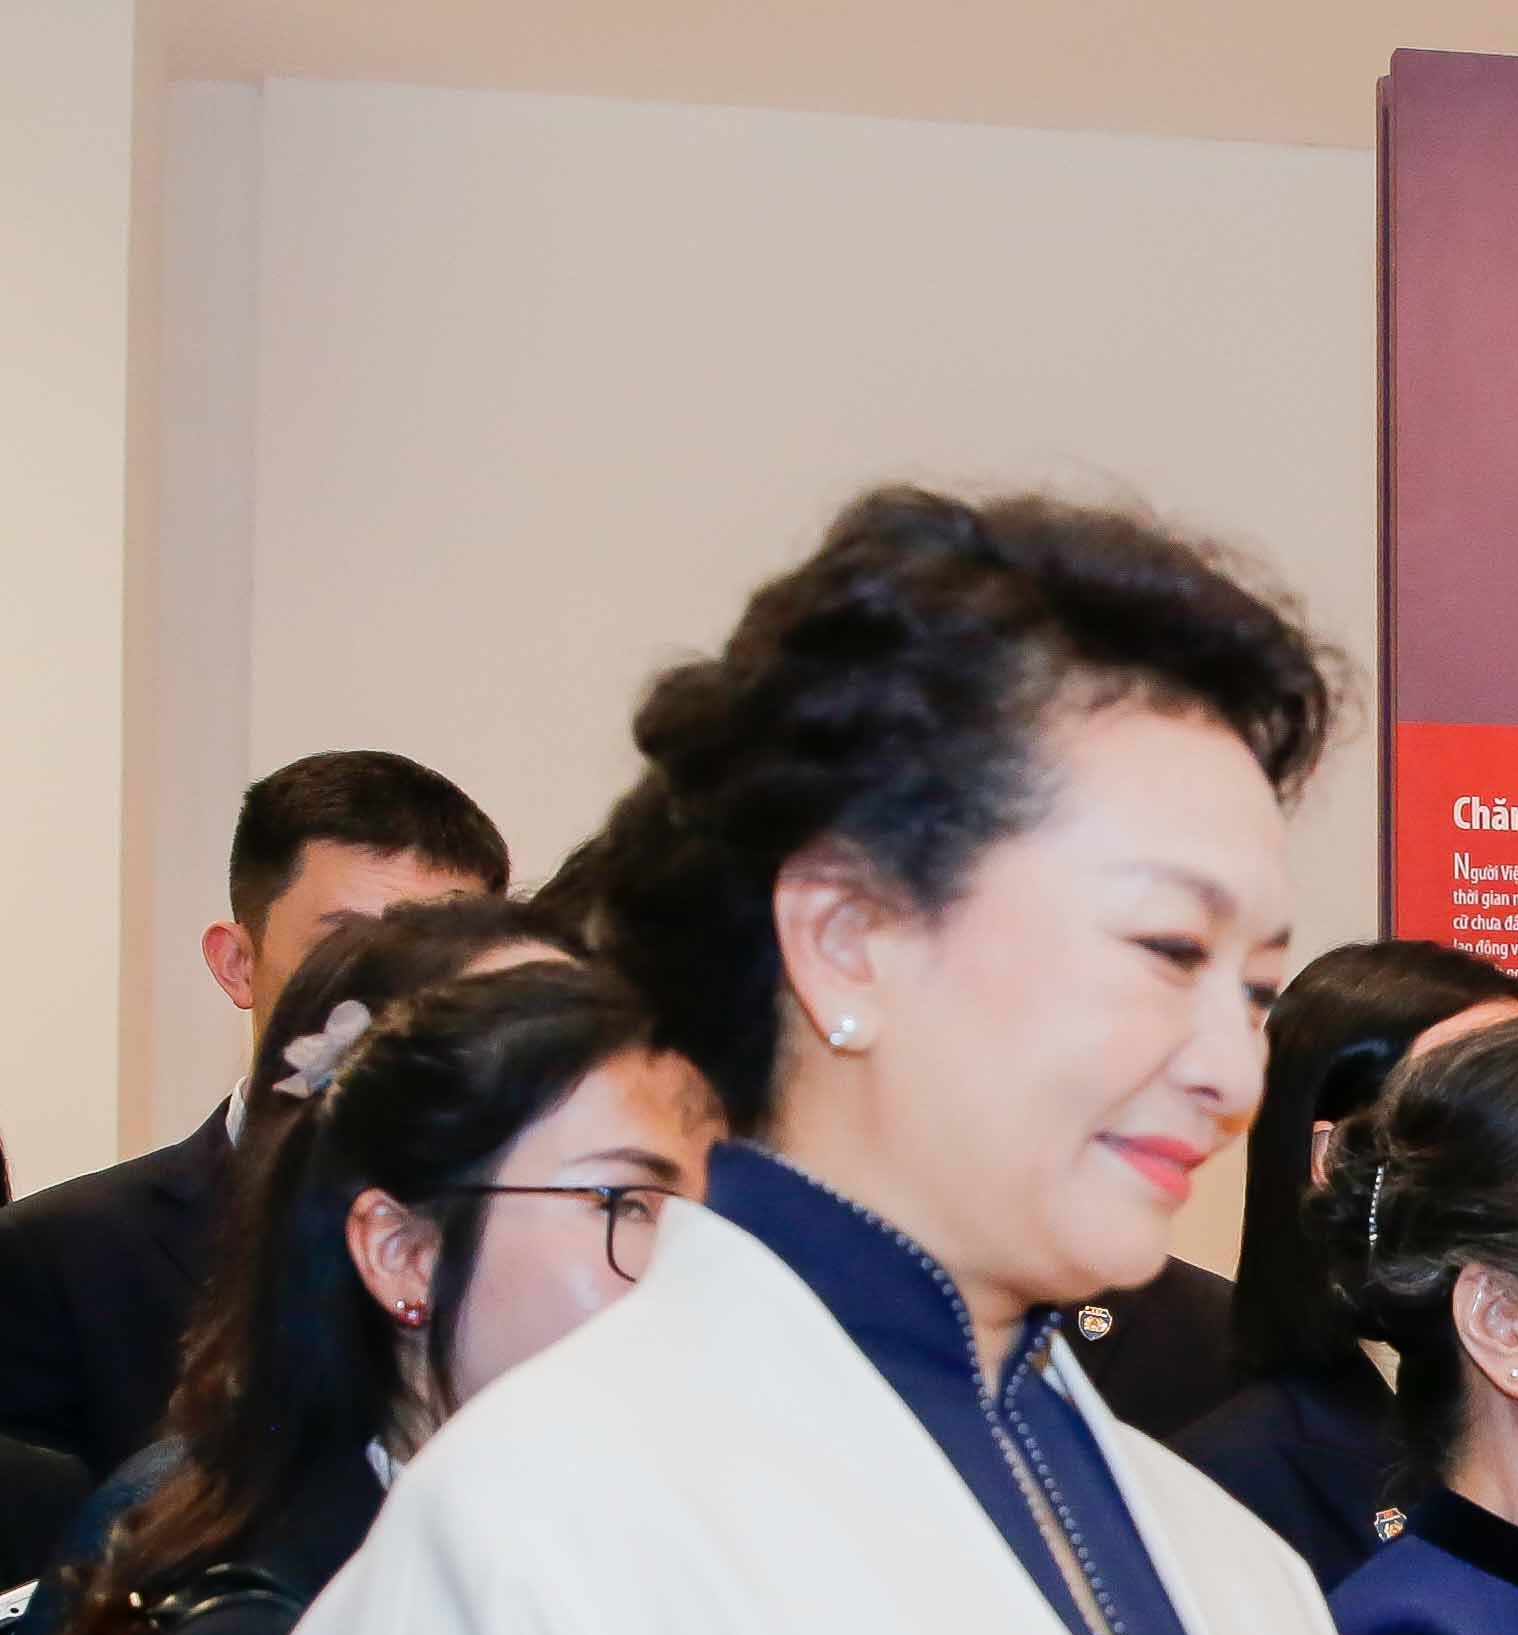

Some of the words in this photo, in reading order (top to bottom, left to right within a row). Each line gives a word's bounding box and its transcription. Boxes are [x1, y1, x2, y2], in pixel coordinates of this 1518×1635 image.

[1455, 852, 1498, 883] Người
[1454, 889, 1478, 904] thời
[1482, 890, 1509, 909] gian
[1454, 915, 1468, 929] cữ
[1471, 914, 1501, 930] chưa
